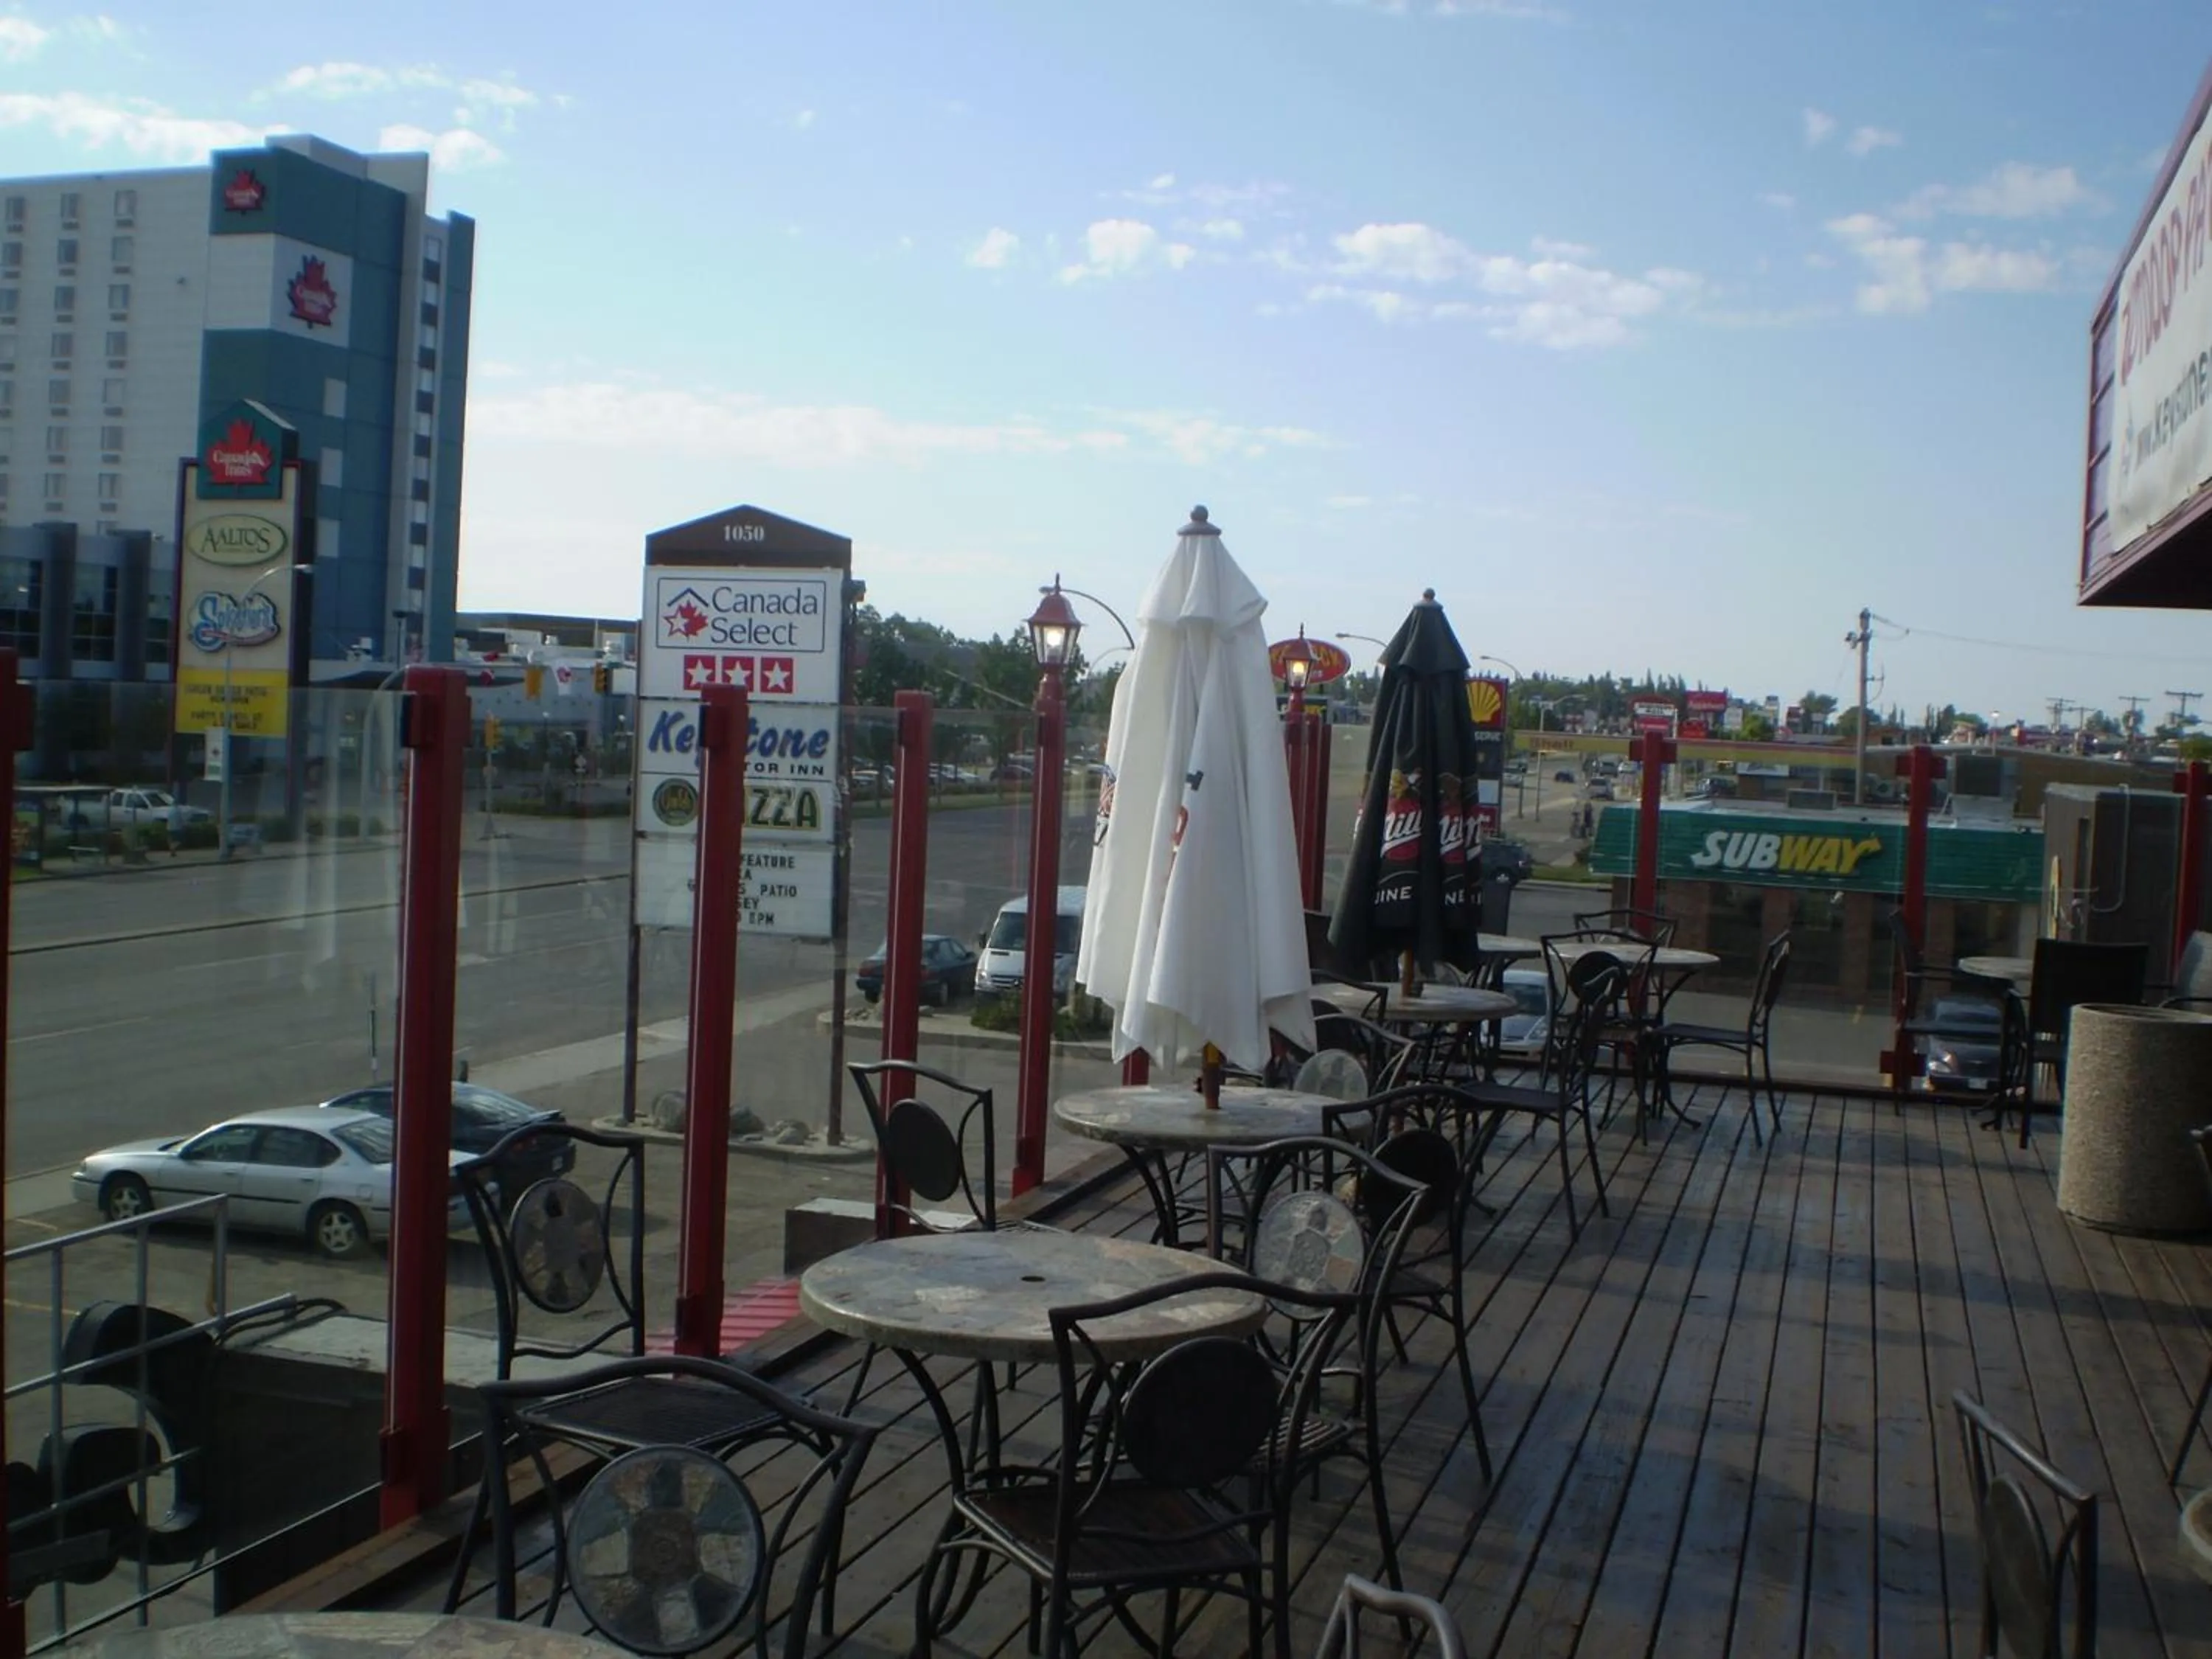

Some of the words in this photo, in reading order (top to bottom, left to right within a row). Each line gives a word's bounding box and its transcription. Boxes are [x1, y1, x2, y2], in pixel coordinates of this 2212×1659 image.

[202, 526, 271, 554] AALTOS
[724, 524, 765, 542] 1050
[712, 586, 818, 615] Canada
[710, 617, 799, 646] Select
[790, 763, 824, 776] INN
[747, 786, 819, 828] ZZA
[1690, 830, 1882, 875] SUBWAY
[760, 884, 797, 897] PATIO
